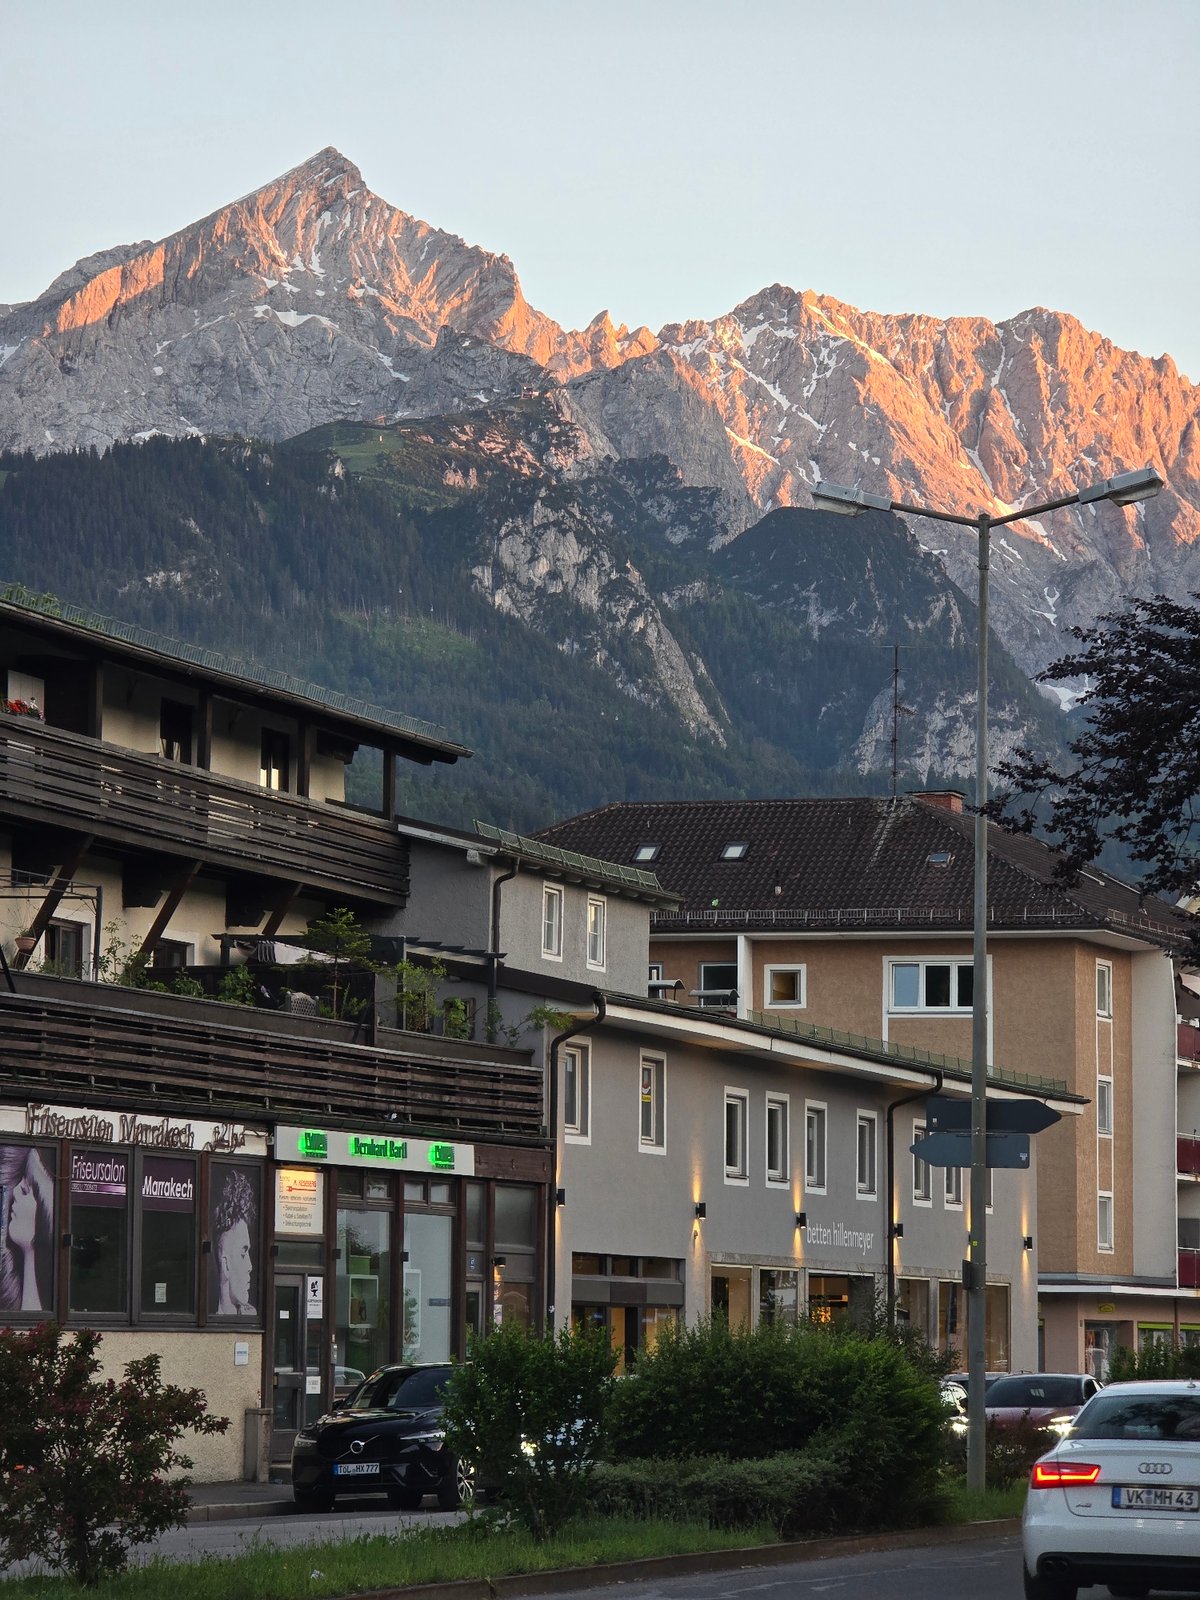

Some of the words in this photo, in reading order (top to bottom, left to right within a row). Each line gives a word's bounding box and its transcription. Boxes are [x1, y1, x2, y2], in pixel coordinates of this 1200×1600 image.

[29, 1103, 113, 1142] Friseursalon
[119, 1114, 195, 1148] Marrakech
[354, 1137, 387, 1157] Bernhard
[71, 1155, 125, 1182] Friseursalon
[142, 1175, 193, 1198] Marrakech
[806, 1218, 832, 1245] betten
[832, 1221, 874, 1256] hillenmeyer
[339, 1465, 351, 1473] TÖL
[356, 1465, 365, 1473] HX
[366, 1464, 378, 1472] 777
[1126, 1489, 1145, 1504] VK
[1154, 1490, 1173, 1505] MH
[1176, 1491, 1194, 1506] 43
